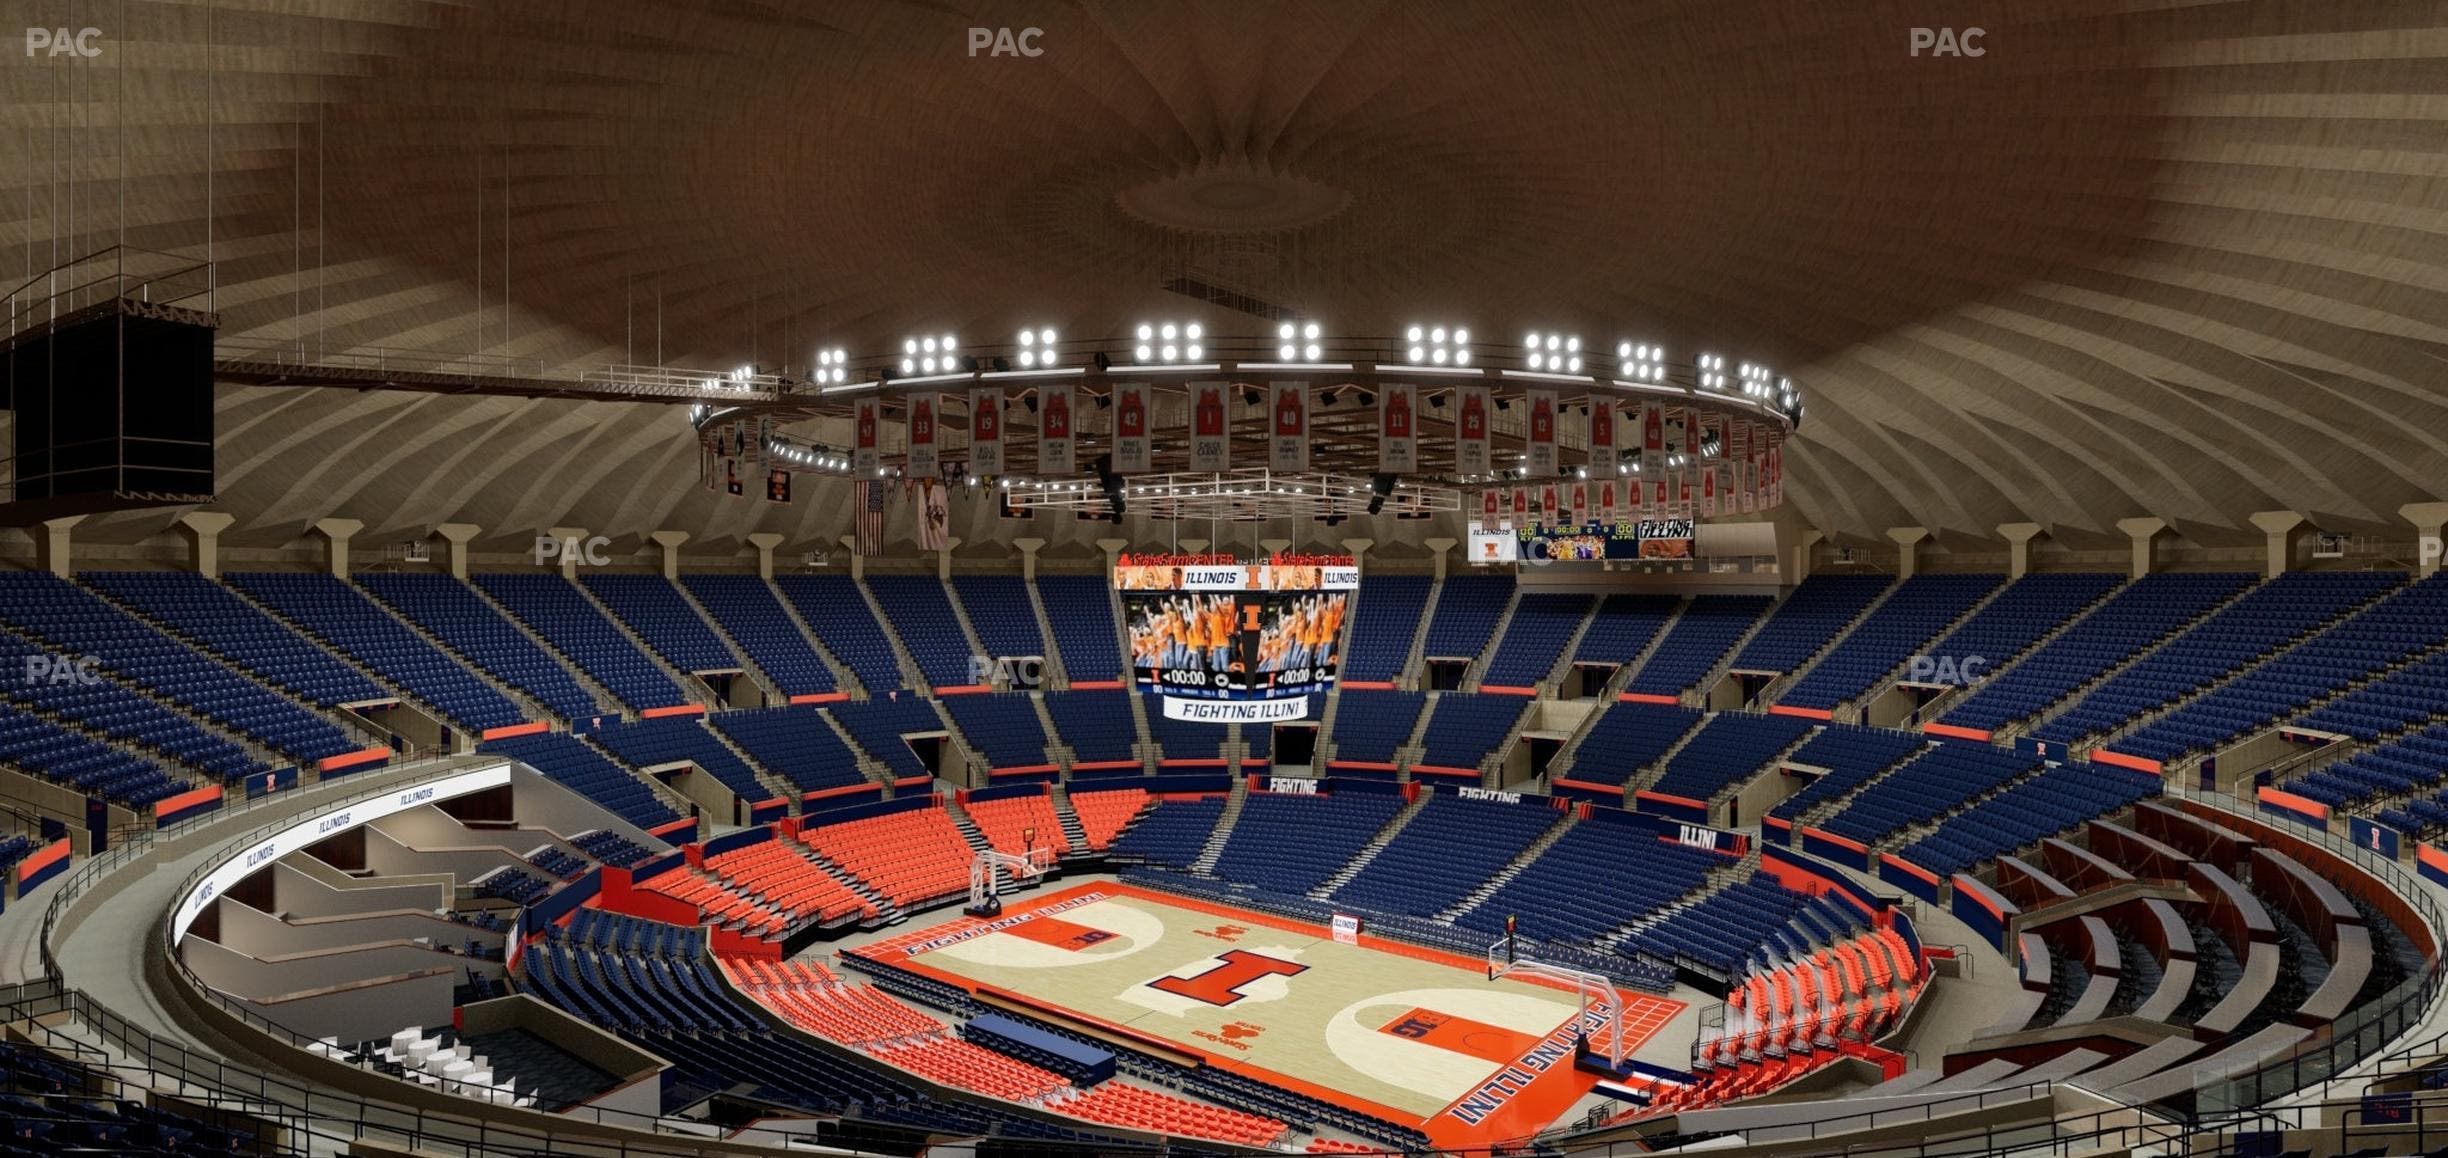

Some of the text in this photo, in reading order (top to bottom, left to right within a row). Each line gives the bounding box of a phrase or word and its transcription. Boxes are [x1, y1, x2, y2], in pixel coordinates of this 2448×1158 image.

[1472, 528, 1511, 536] ILLINOIS
[1641, 519, 1692, 530] FIGHTING
[1185, 572, 1238, 584] ILLINOIS
[1324, 572, 1358, 584] ILLINOIS
[1171, 669, 1206, 686] 00:00
[1284, 668, 1310, 685] 00:00
[1183, 702, 1300, 718] FIGHTING ILLINI
[1269, 777, 1318, 795] FIGHTING
[400, 787, 434, 806] ILLINOIS
[1458, 786, 1521, 805] FIGHTING
[318, 812, 351, 836] ILLINOIS
[1680, 824, 1717, 850] ILLINI
[246, 843, 275, 870] ILLINOIS
[903, 891, 1107, 955] FIGHTING ILLINI
[1450, 1001, 1614, 1127] FIGHTING ILLINI
